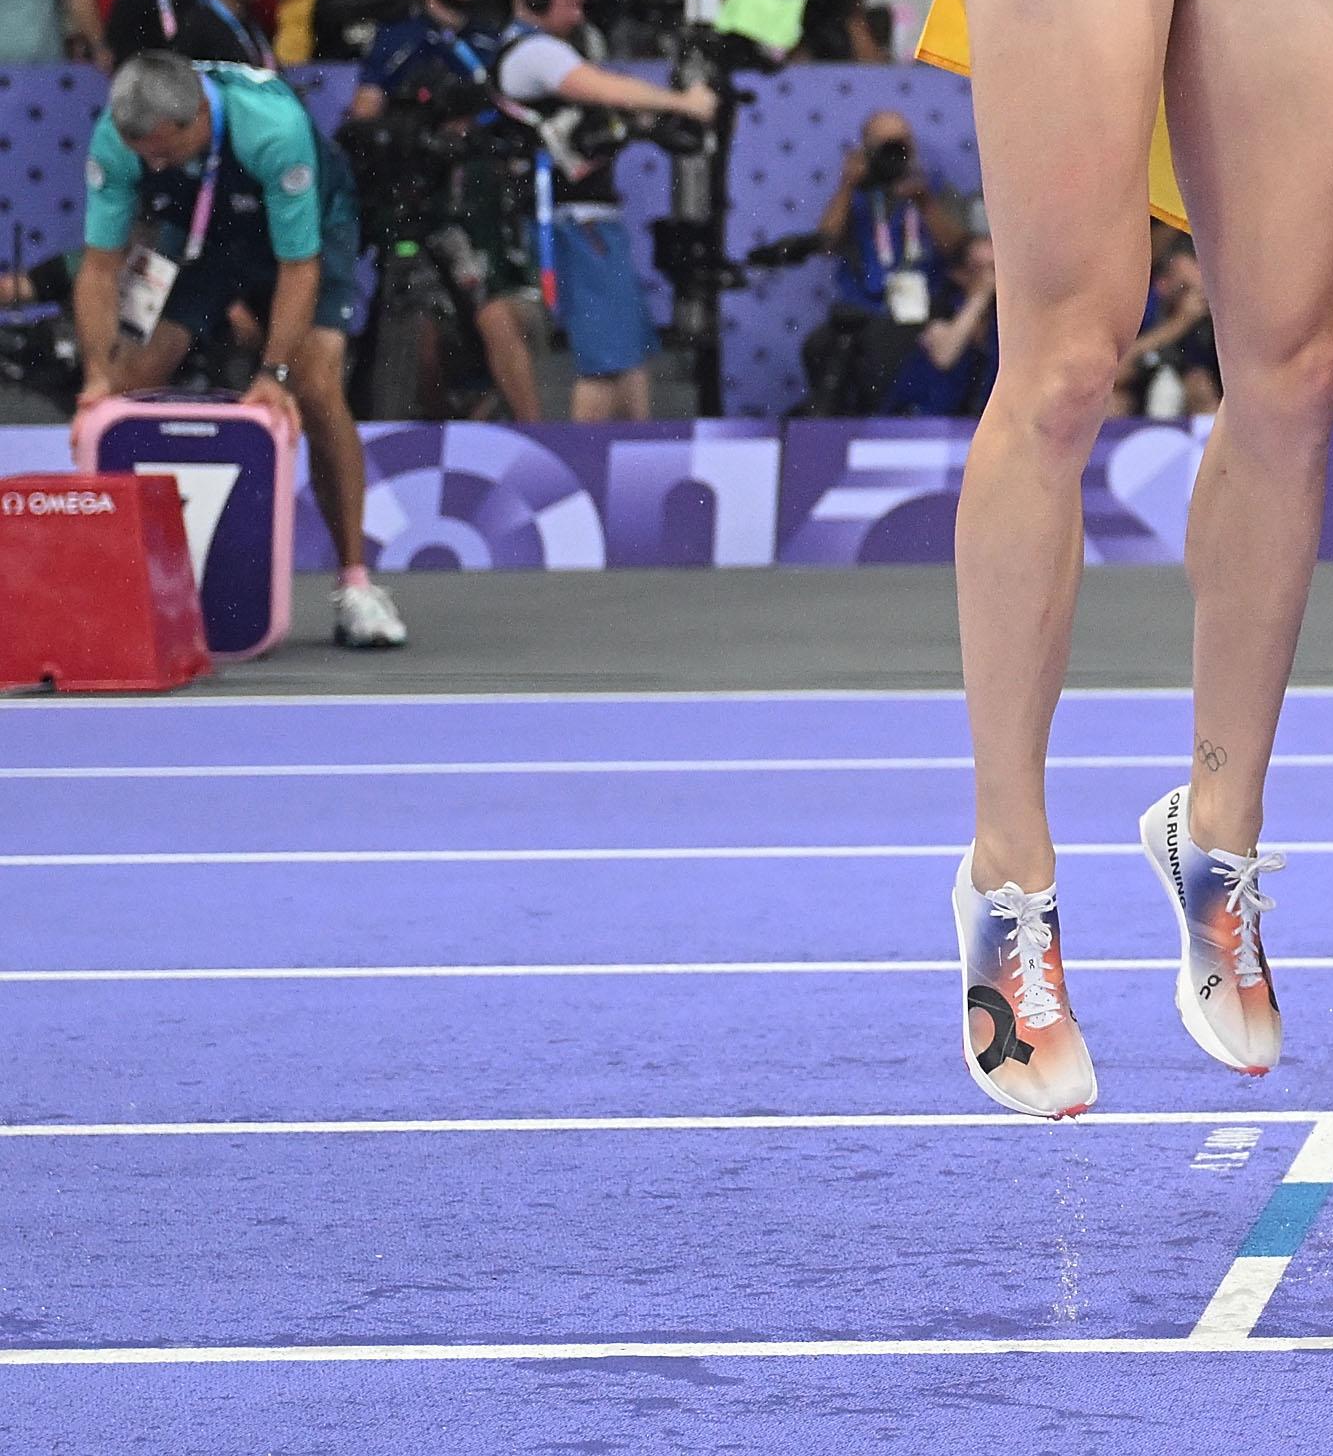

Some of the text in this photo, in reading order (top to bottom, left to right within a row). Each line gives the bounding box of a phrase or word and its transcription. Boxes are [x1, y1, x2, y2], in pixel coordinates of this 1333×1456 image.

[27, 491, 117, 516] OMEGA
[1166, 792, 1187, 910] ON RUNNING
